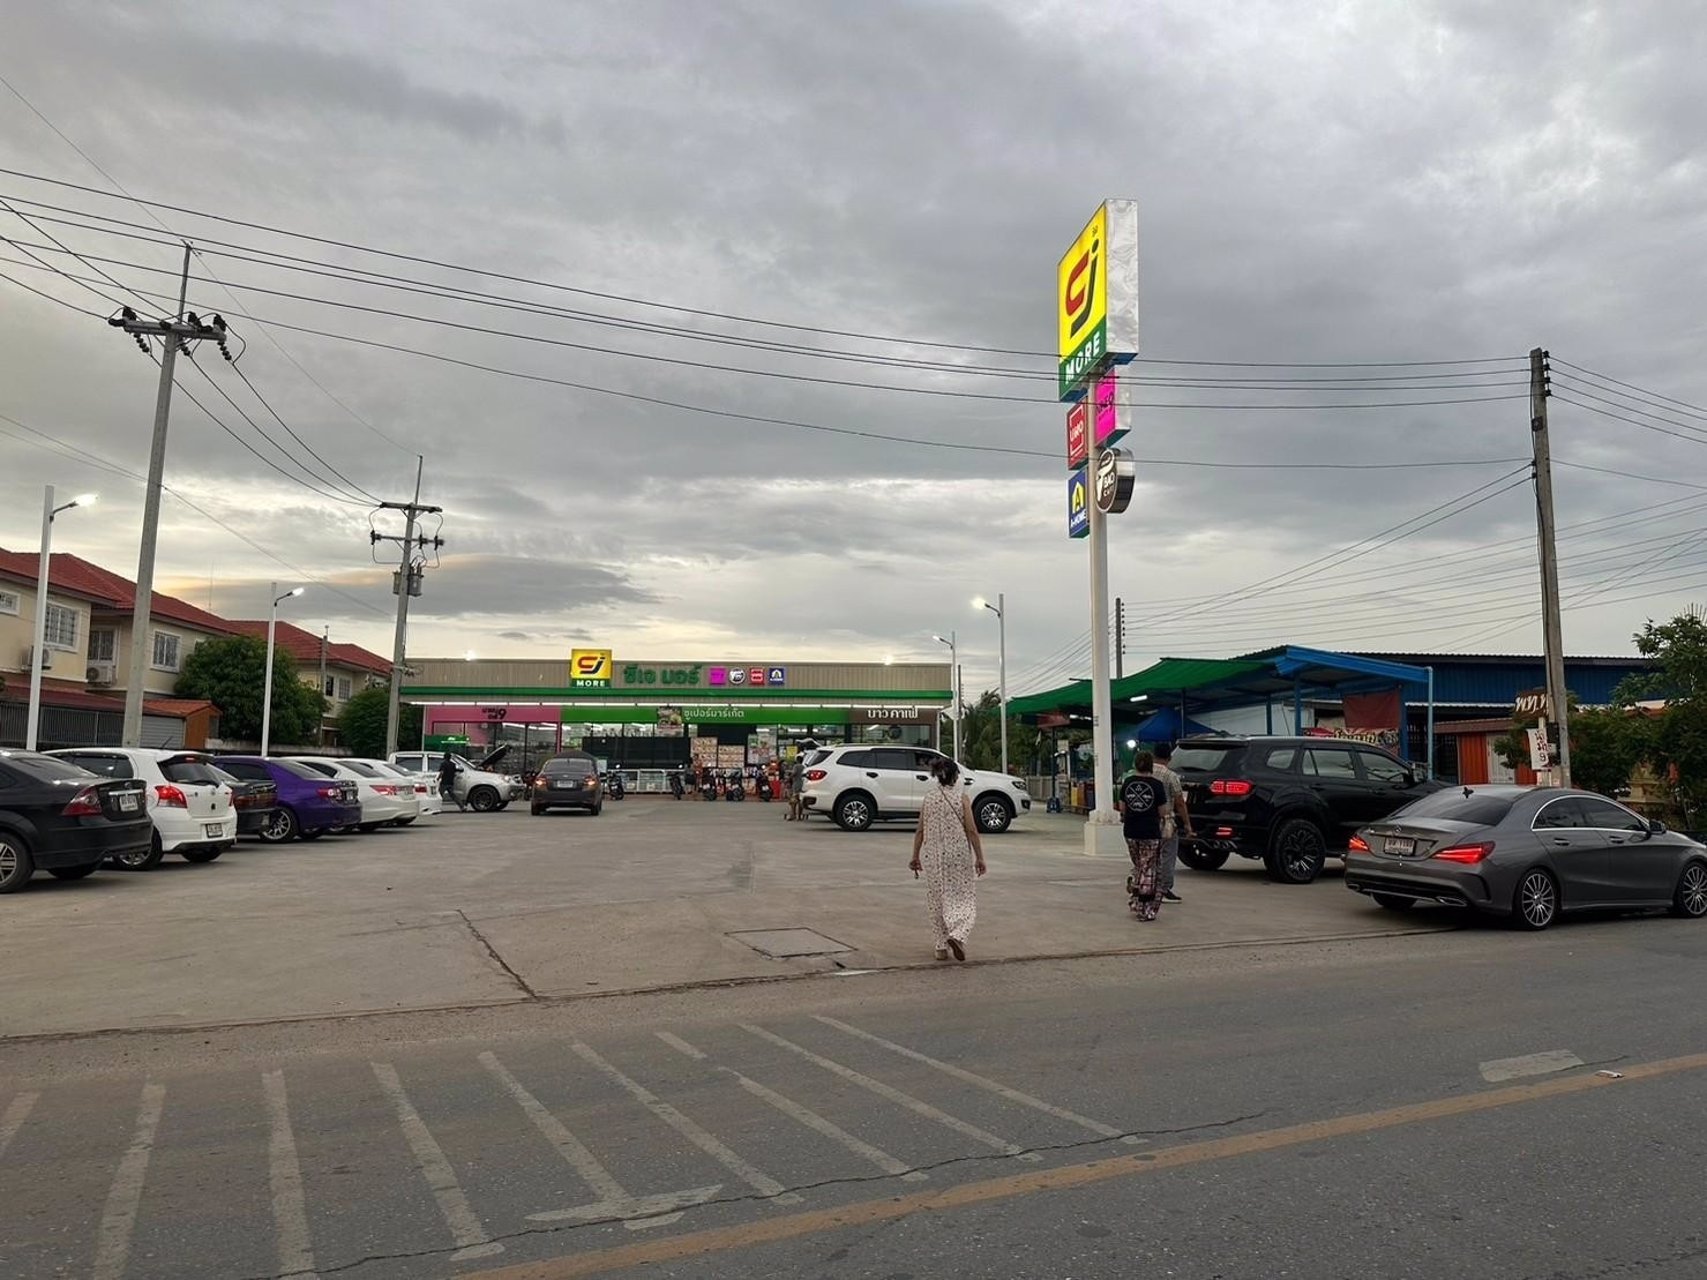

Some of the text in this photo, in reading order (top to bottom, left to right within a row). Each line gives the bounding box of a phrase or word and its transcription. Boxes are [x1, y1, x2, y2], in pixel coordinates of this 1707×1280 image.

[1065, 331, 1101, 385] MORE
[661, 663, 703, 685] มอร์
[683, 709, 745, 721] ซูเปอร์มาร์เก็ต
[867, 709, 889, 719] บาว
